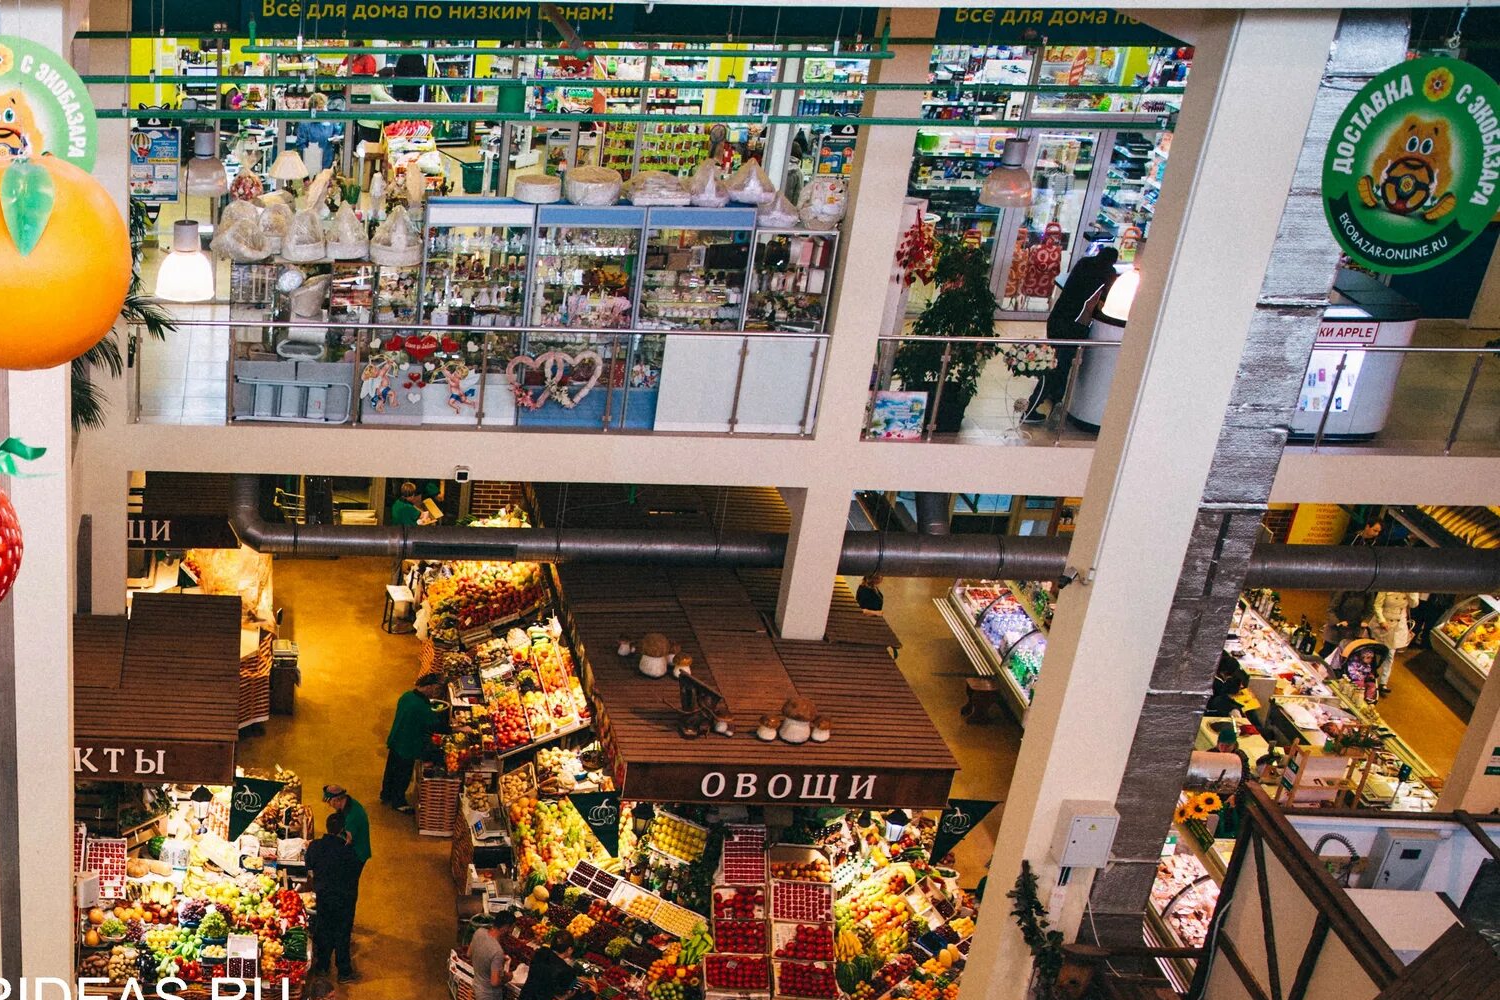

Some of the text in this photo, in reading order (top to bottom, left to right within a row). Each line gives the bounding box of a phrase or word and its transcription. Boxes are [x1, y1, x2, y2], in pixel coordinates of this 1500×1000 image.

[307, 3, 346, 20] для
[353, 4, 410, 21] дома
[415, 5, 442, 19] по
[449, 5, 532, 20] низким
[1000, 9, 1044, 26] для
[1048, 10, 1108, 26] дома
[1332, 74, 1414, 176] ДОСТАВКА
[1455, 83, 1473, 105] С
[1338, 211, 1449, 260] EKOBAZAR-ONLINE.RU
[1336, 327, 1374, 338] APPLE
[701, 771, 878, 803] ОВОЩИ
